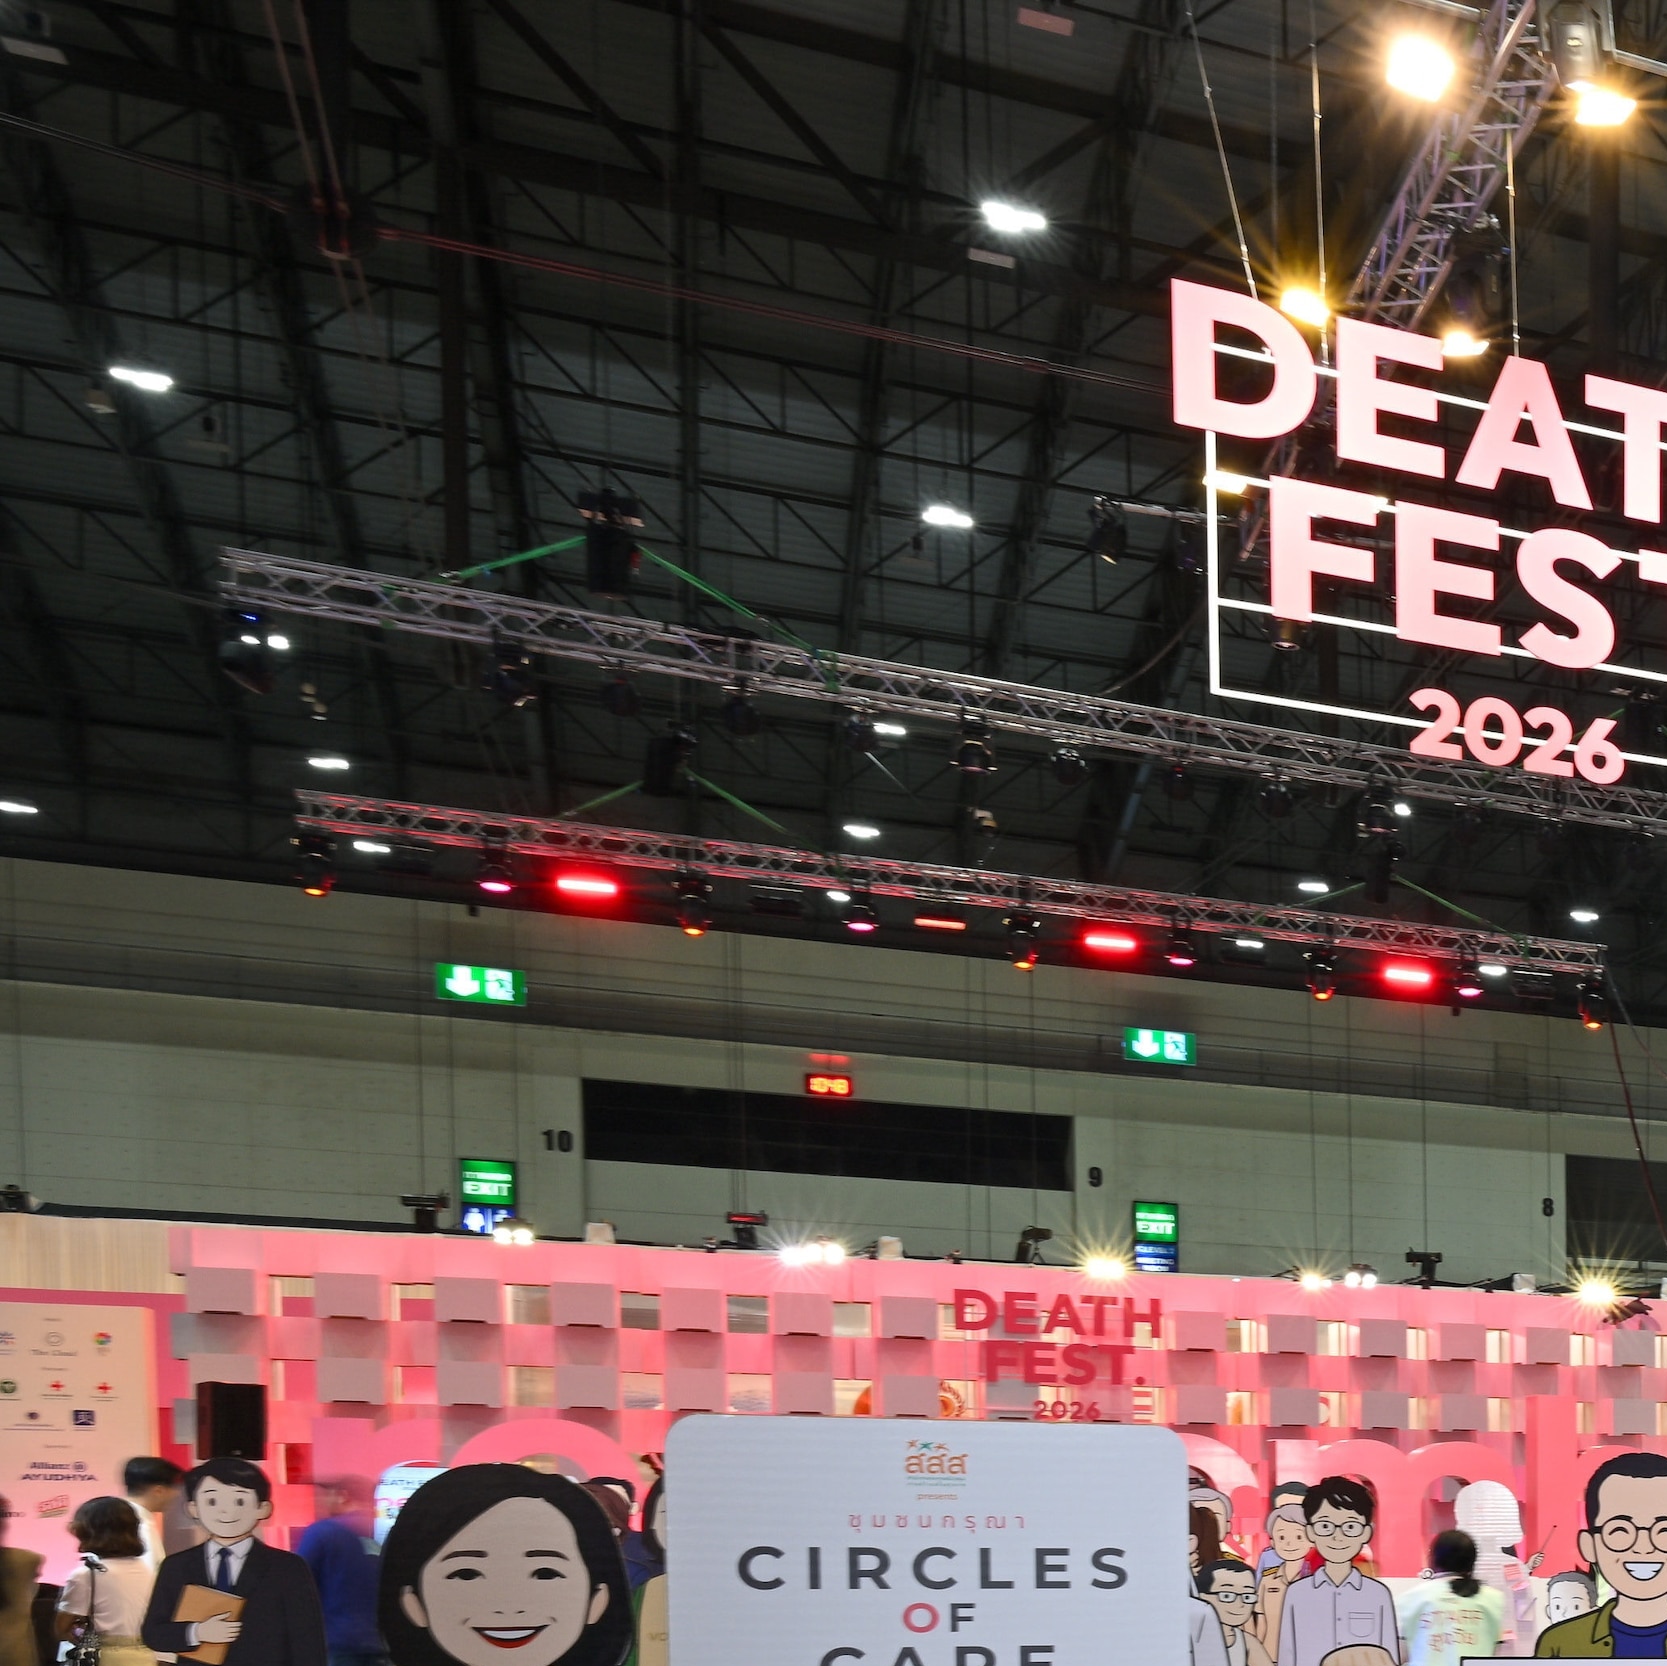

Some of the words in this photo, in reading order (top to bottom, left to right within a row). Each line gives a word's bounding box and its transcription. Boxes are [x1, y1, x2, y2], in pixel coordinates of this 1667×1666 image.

[1408, 688, 1625, 785] 2026
[542, 1129, 573, 1152] 10
[1088, 1166, 1103, 1187] 9
[463, 1181, 512, 1196] EXIT
[1136, 1221, 1175, 1234] EXIT
[954, 1288, 1161, 1338] DEATH
[986, 1340, 1145, 1386] FEST.
[1034, 1400, 1099, 1421] 2026
[905, 1452, 969, 1475] สสส
[848, 1513, 1026, 1534] ชุมชนกรุณา
[738, 1546, 1129, 1591] CIRCLES
[903, 1602, 977, 1634] OF
[1419, 1609, 1485, 1629] STAFF
